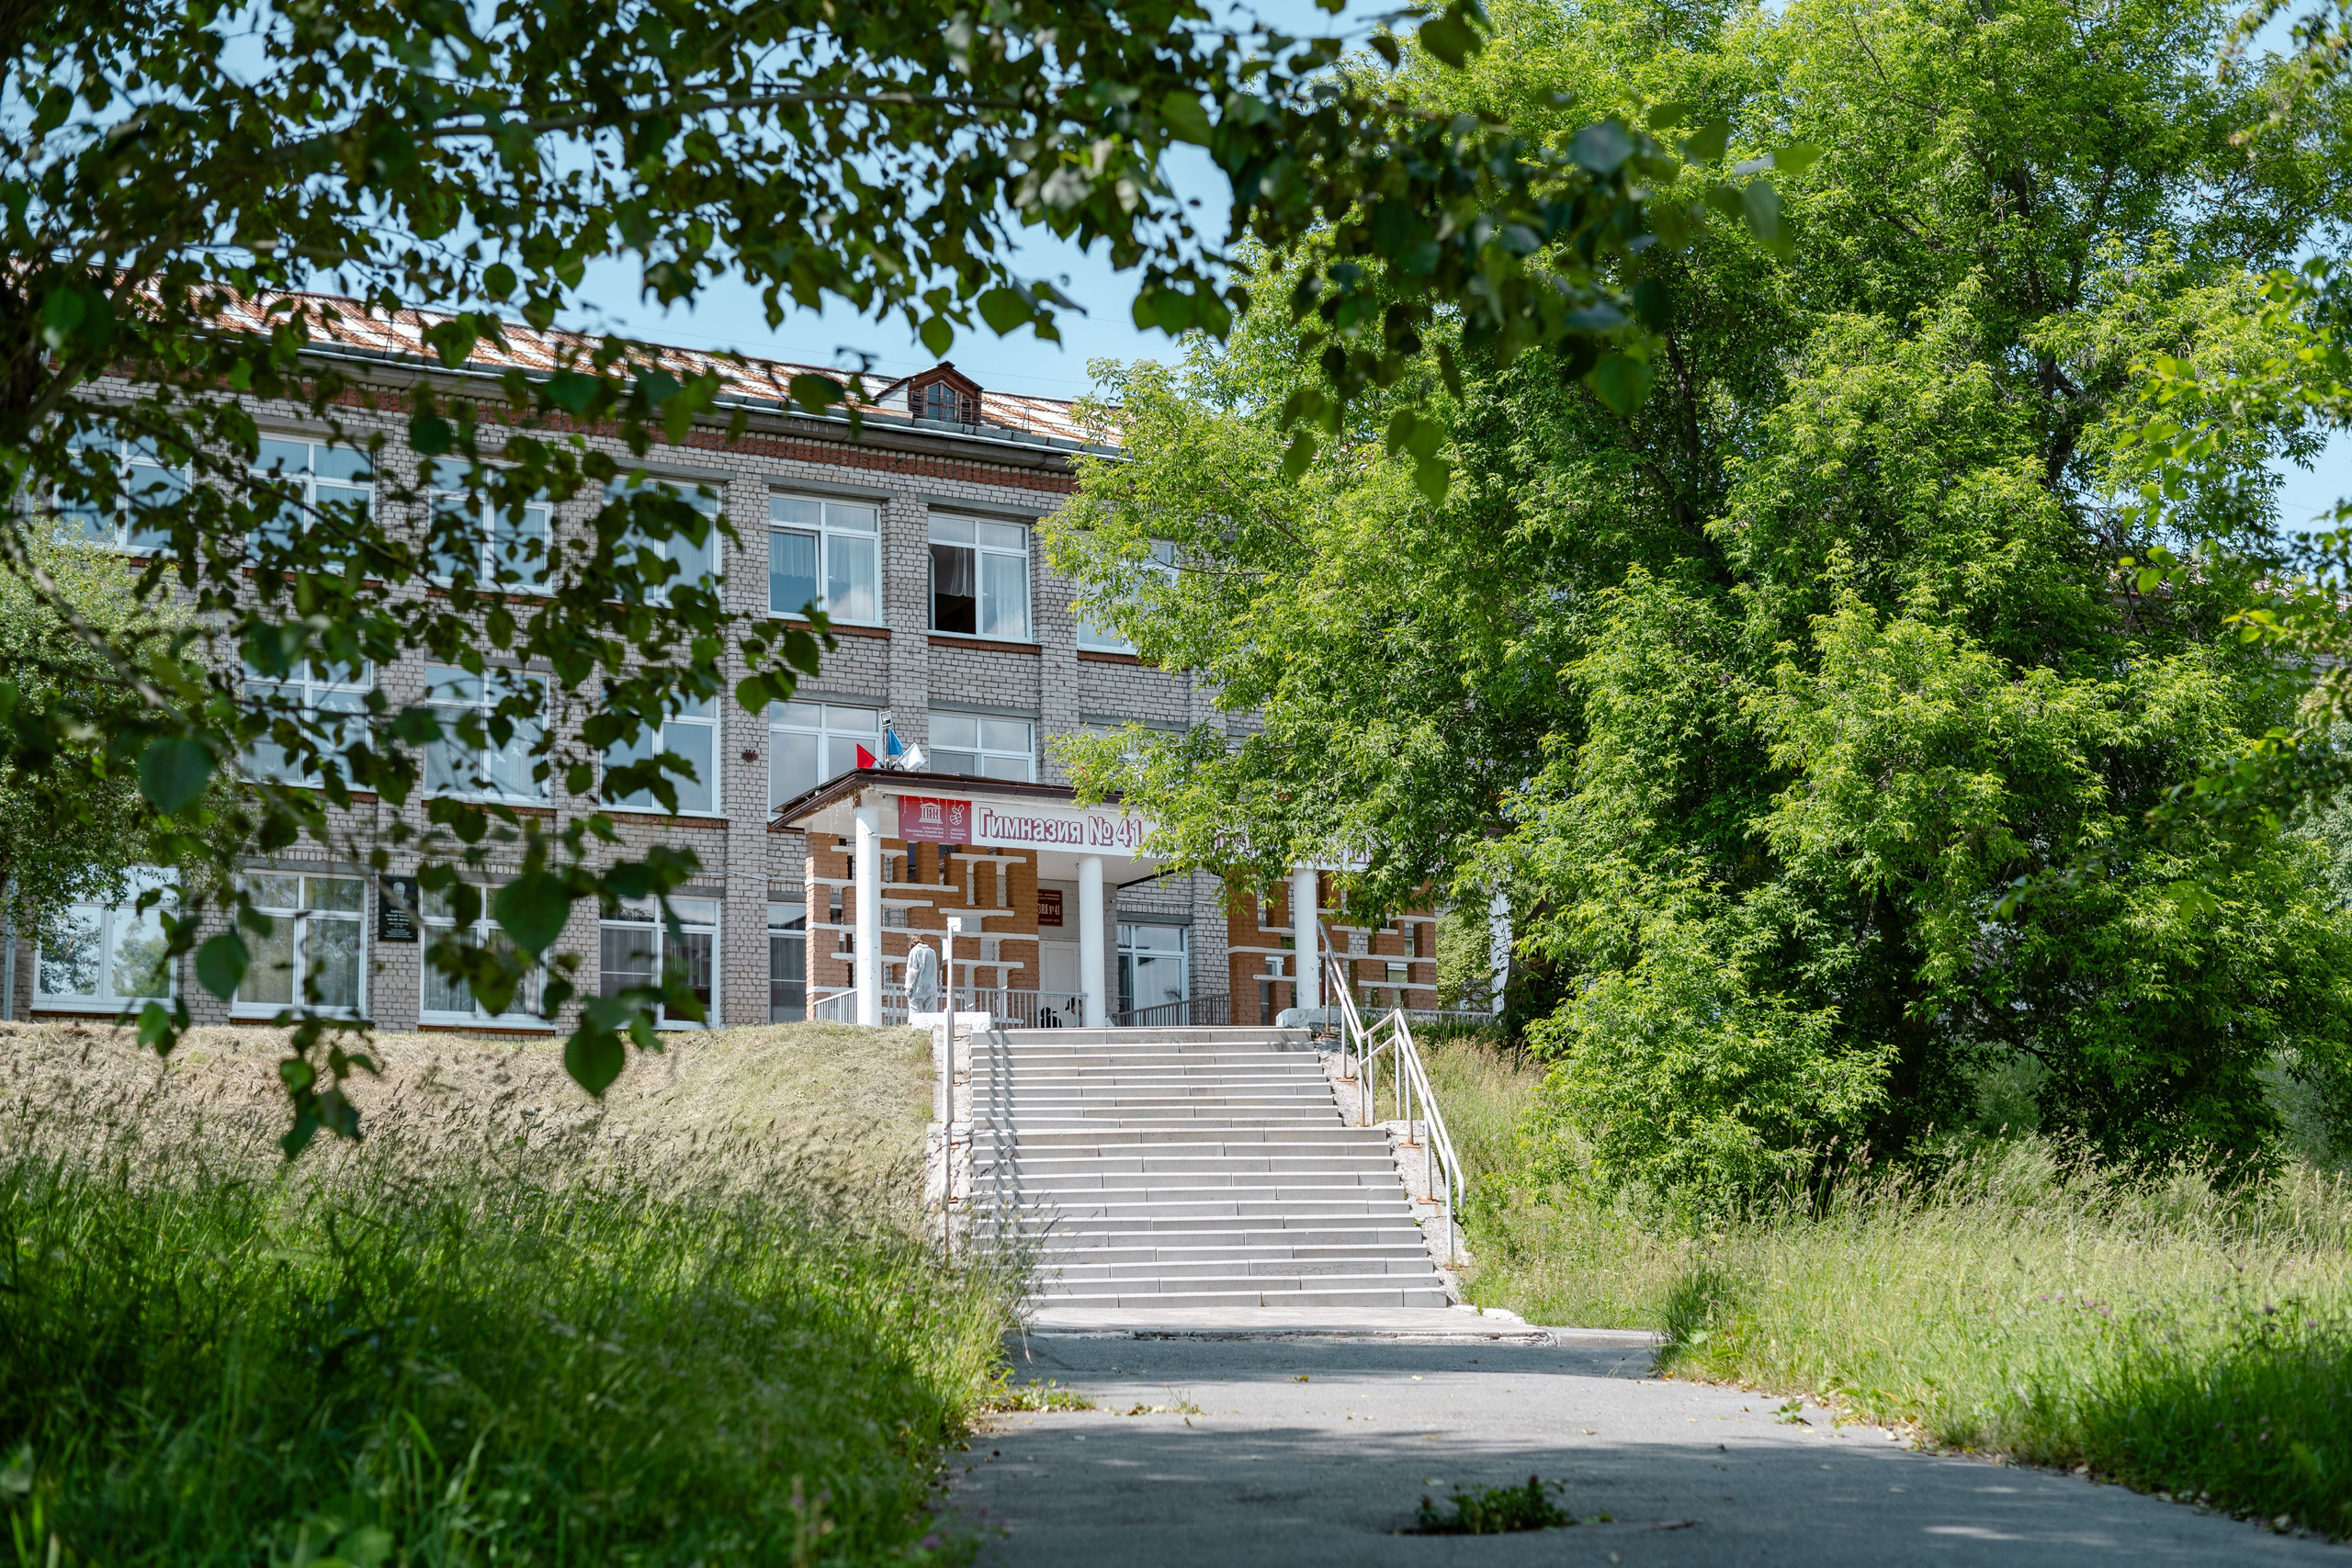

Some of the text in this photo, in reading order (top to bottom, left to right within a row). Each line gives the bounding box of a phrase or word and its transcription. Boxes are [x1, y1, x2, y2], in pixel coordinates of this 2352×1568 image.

[979, 807, 1142, 848] Гимназия № 41
